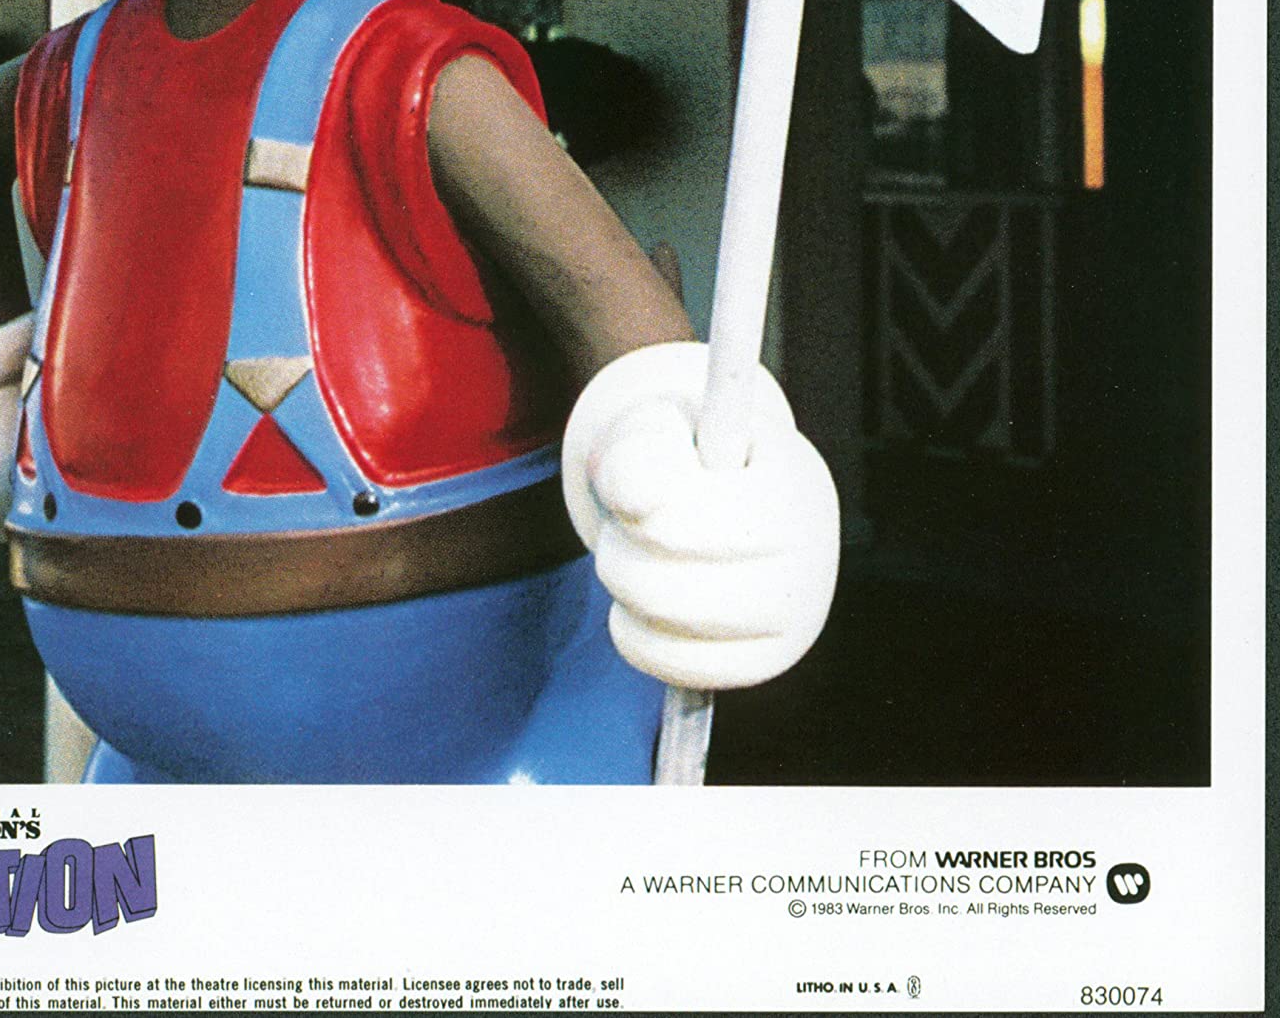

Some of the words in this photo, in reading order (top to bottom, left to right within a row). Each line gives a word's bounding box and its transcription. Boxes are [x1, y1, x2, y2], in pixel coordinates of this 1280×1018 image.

[859, 849, 928, 869] FROM
[934, 850, 1028, 869] WARNER
[1033, 850, 1097, 869] BROS
[620, 876, 636, 894] A
[643, 875, 743, 894] WARNER
[751, 874, 971, 894] COMMUNICATIONS
[978, 875, 1097, 894] COMPANY
[812, 903, 842, 914] 1983
[847, 903, 894, 914] Warner
[967, 903, 983, 914] All
[988, 903, 1029, 917] Rights
[1034, 903, 1096, 915] Reserved
[47, 977, 60, 992] of
[64, 977, 90, 991] this
[95, 978, 142, 994] picture
[146, 978, 160, 991] at
[164, 977, 186, 992] the
[190, 977, 239, 992] theatre
[243, 977, 303, 994] licensing
[308, 977, 334, 991] this
[402, 977, 461, 991] Licensee
[464, 979, 509, 994] agrees
[513, 977, 535, 991] not
[538, 977, 552, 991] to
[600, 977, 624, 991] sell
[15, 996, 41, 1010] this
[111, 995, 141, 1010] This
[147, 996, 202, 1010] material
[208, 995, 247, 1010] either
[254, 996, 287, 1009] must
[293, 995, 310, 1010] be
[315, 995, 373, 1010] returned
[378, 998, 393, 1009] or
[398, 995, 464, 1010] destroyed
[470, 995, 553, 1010] immediately
[558, 995, 590, 1009] after
[1080, 985, 1163, 1006] 830074
